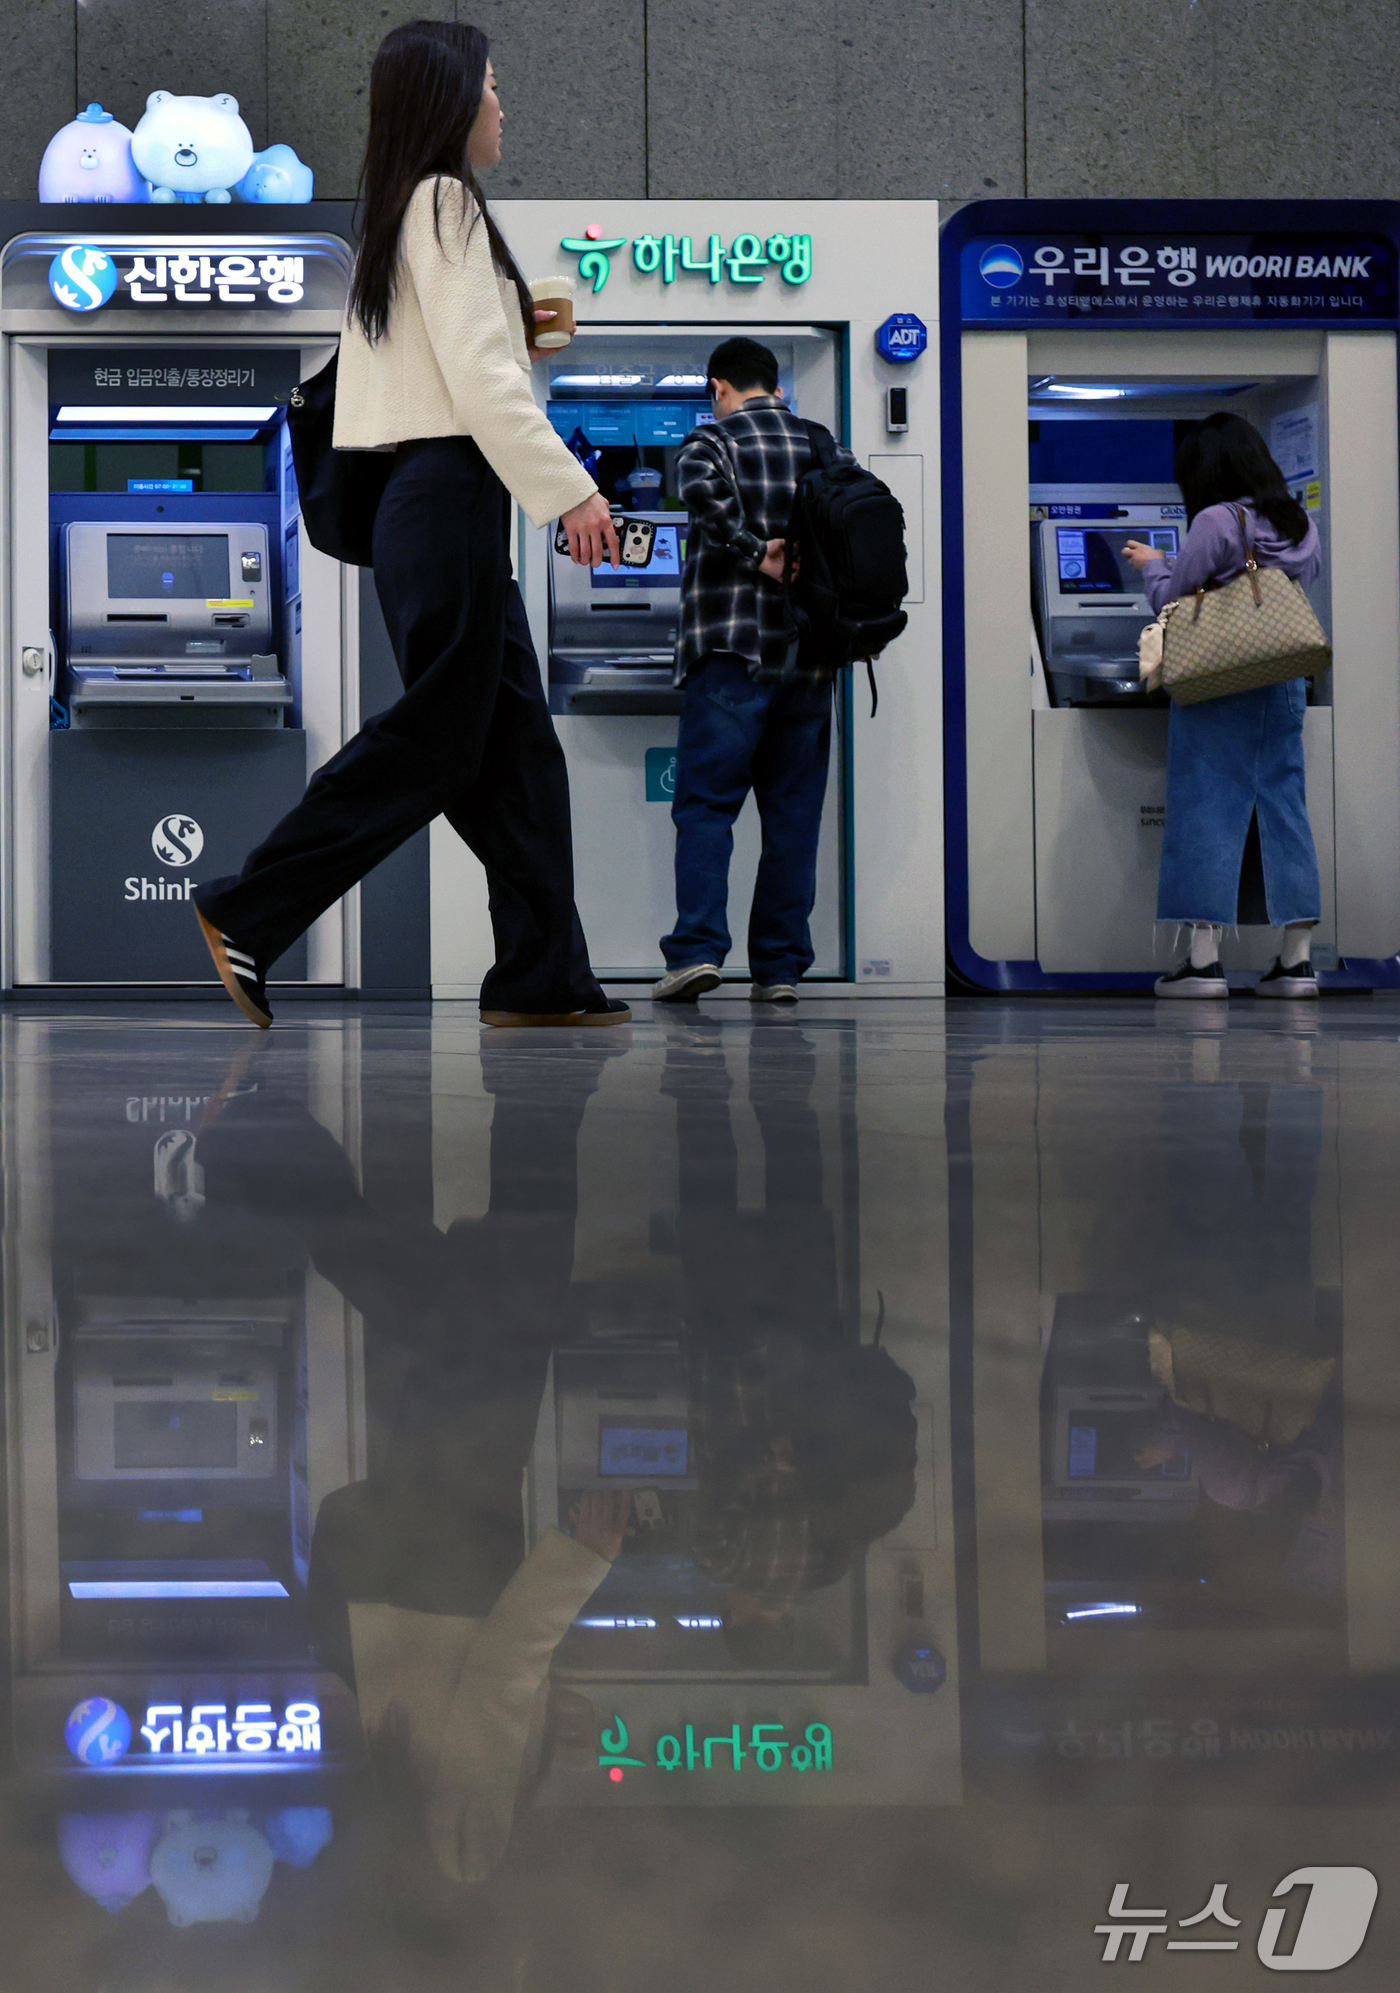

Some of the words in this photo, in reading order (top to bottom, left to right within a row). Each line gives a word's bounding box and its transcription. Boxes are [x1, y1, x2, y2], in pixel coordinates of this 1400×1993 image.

[633, 233, 812, 285] 하나은행
[1028, 246, 1198, 288] 우리은행
[1205, 255, 1291, 278] WOORI
[1295, 255, 1372, 278] BANK
[123, 255, 305, 304] 신한은행
[1006, 295, 1040, 307] 기기는
[1142, 295, 1188, 307] 운영하는
[1266, 295, 1325, 307] 자동화기기
[1329, 295, 1364, 307] 입니다
[889, 329, 920, 345] ADT
[94, 368, 122, 387] 현금
[126, 368, 256, 387] 입금인출/통장정리기
